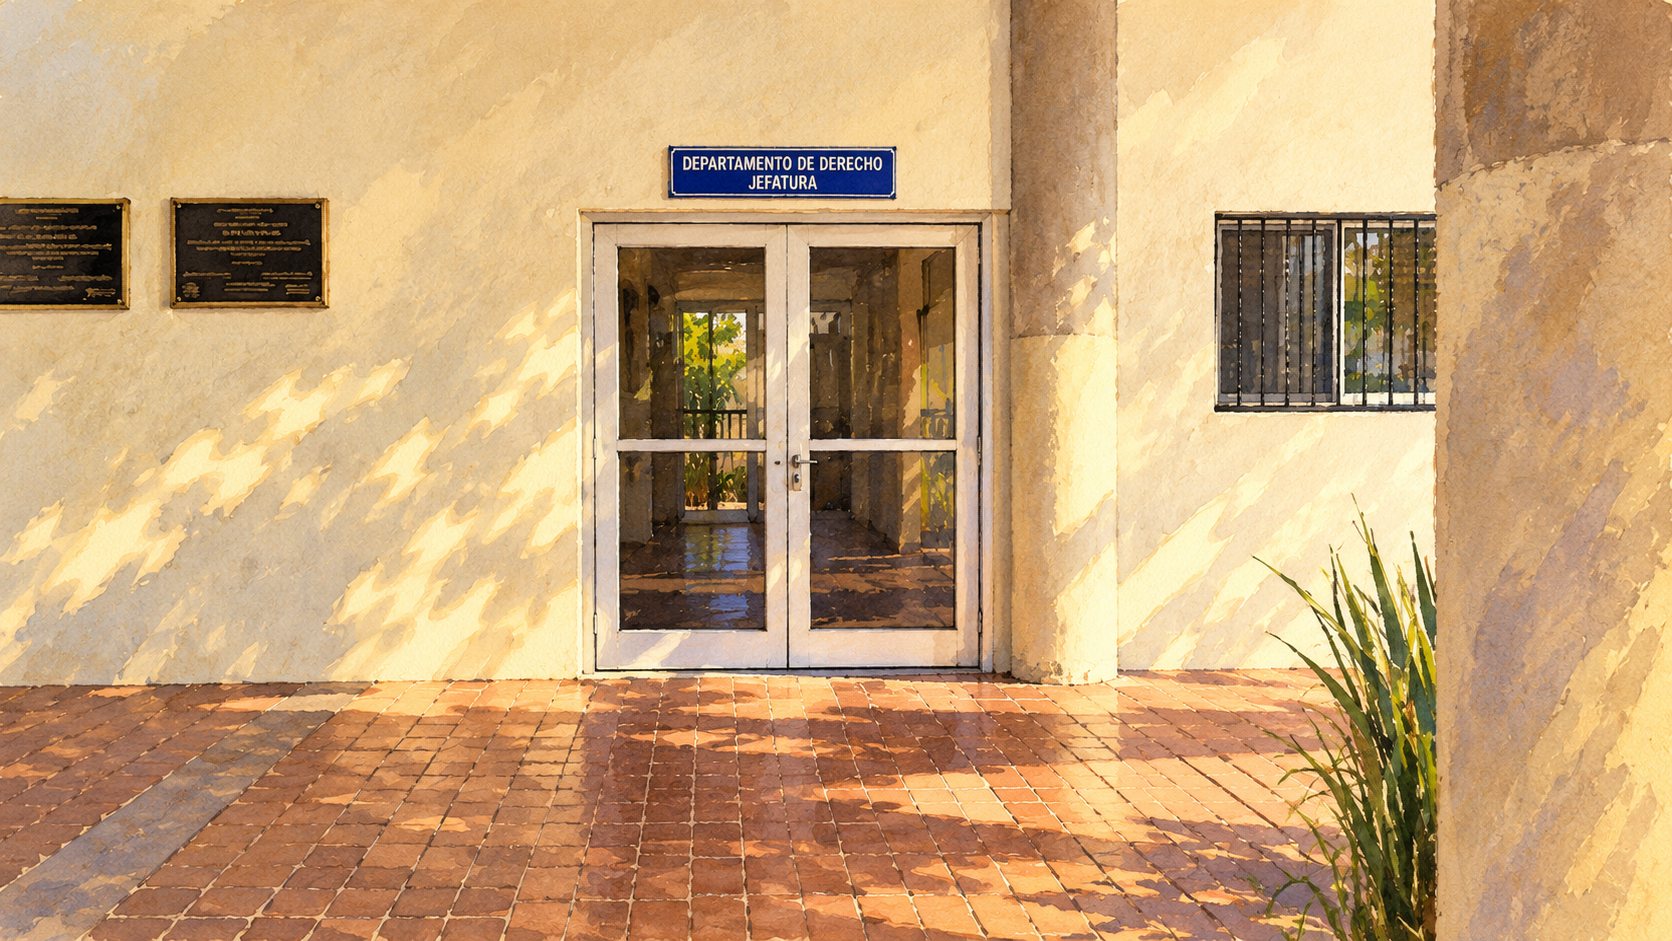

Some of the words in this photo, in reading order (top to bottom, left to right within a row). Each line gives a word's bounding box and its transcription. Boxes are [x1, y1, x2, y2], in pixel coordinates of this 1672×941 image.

[682, 156, 793, 171] DEPARTAMENTO
[797, 156, 815, 171] DE
[819, 156, 883, 171] DERECHO
[748, 175, 818, 190] JEFATURA
